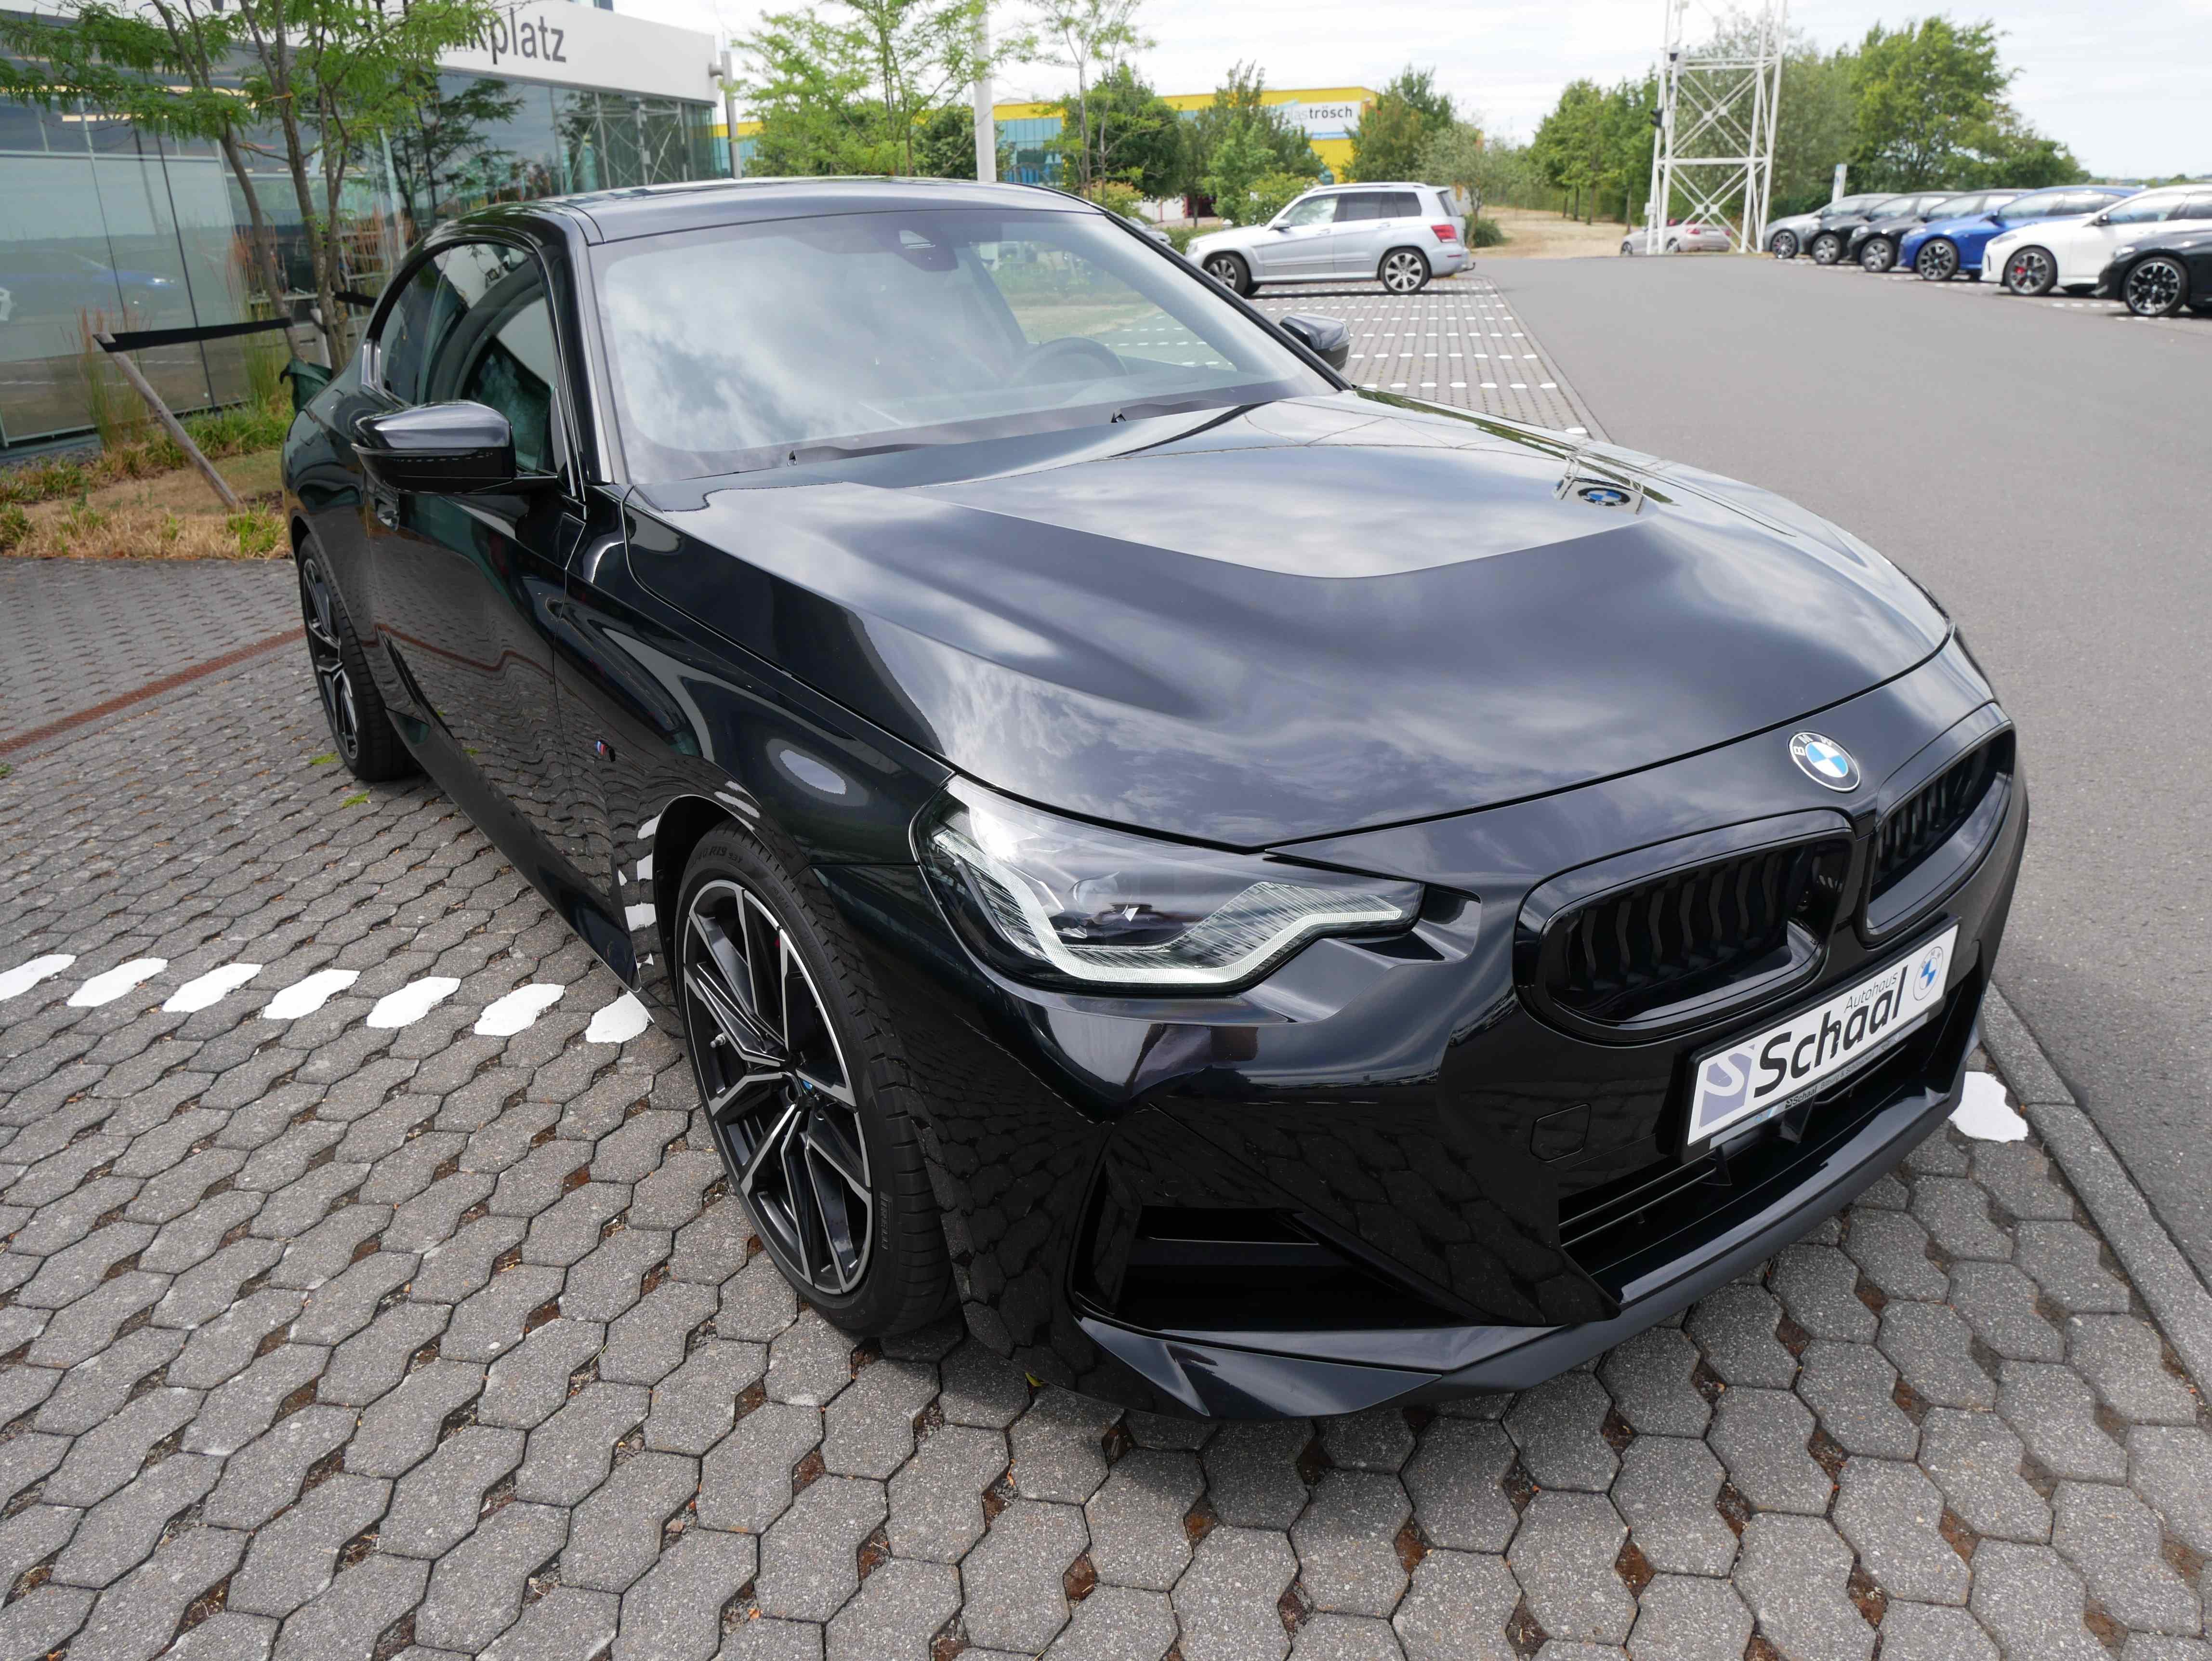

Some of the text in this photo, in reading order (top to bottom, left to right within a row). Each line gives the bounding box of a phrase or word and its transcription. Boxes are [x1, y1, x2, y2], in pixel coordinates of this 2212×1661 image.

[1793, 734, 1832, 756] BMW
[1844, 972, 1898, 1014] Autohaus
[1753, 964, 1909, 1098] Schaal
